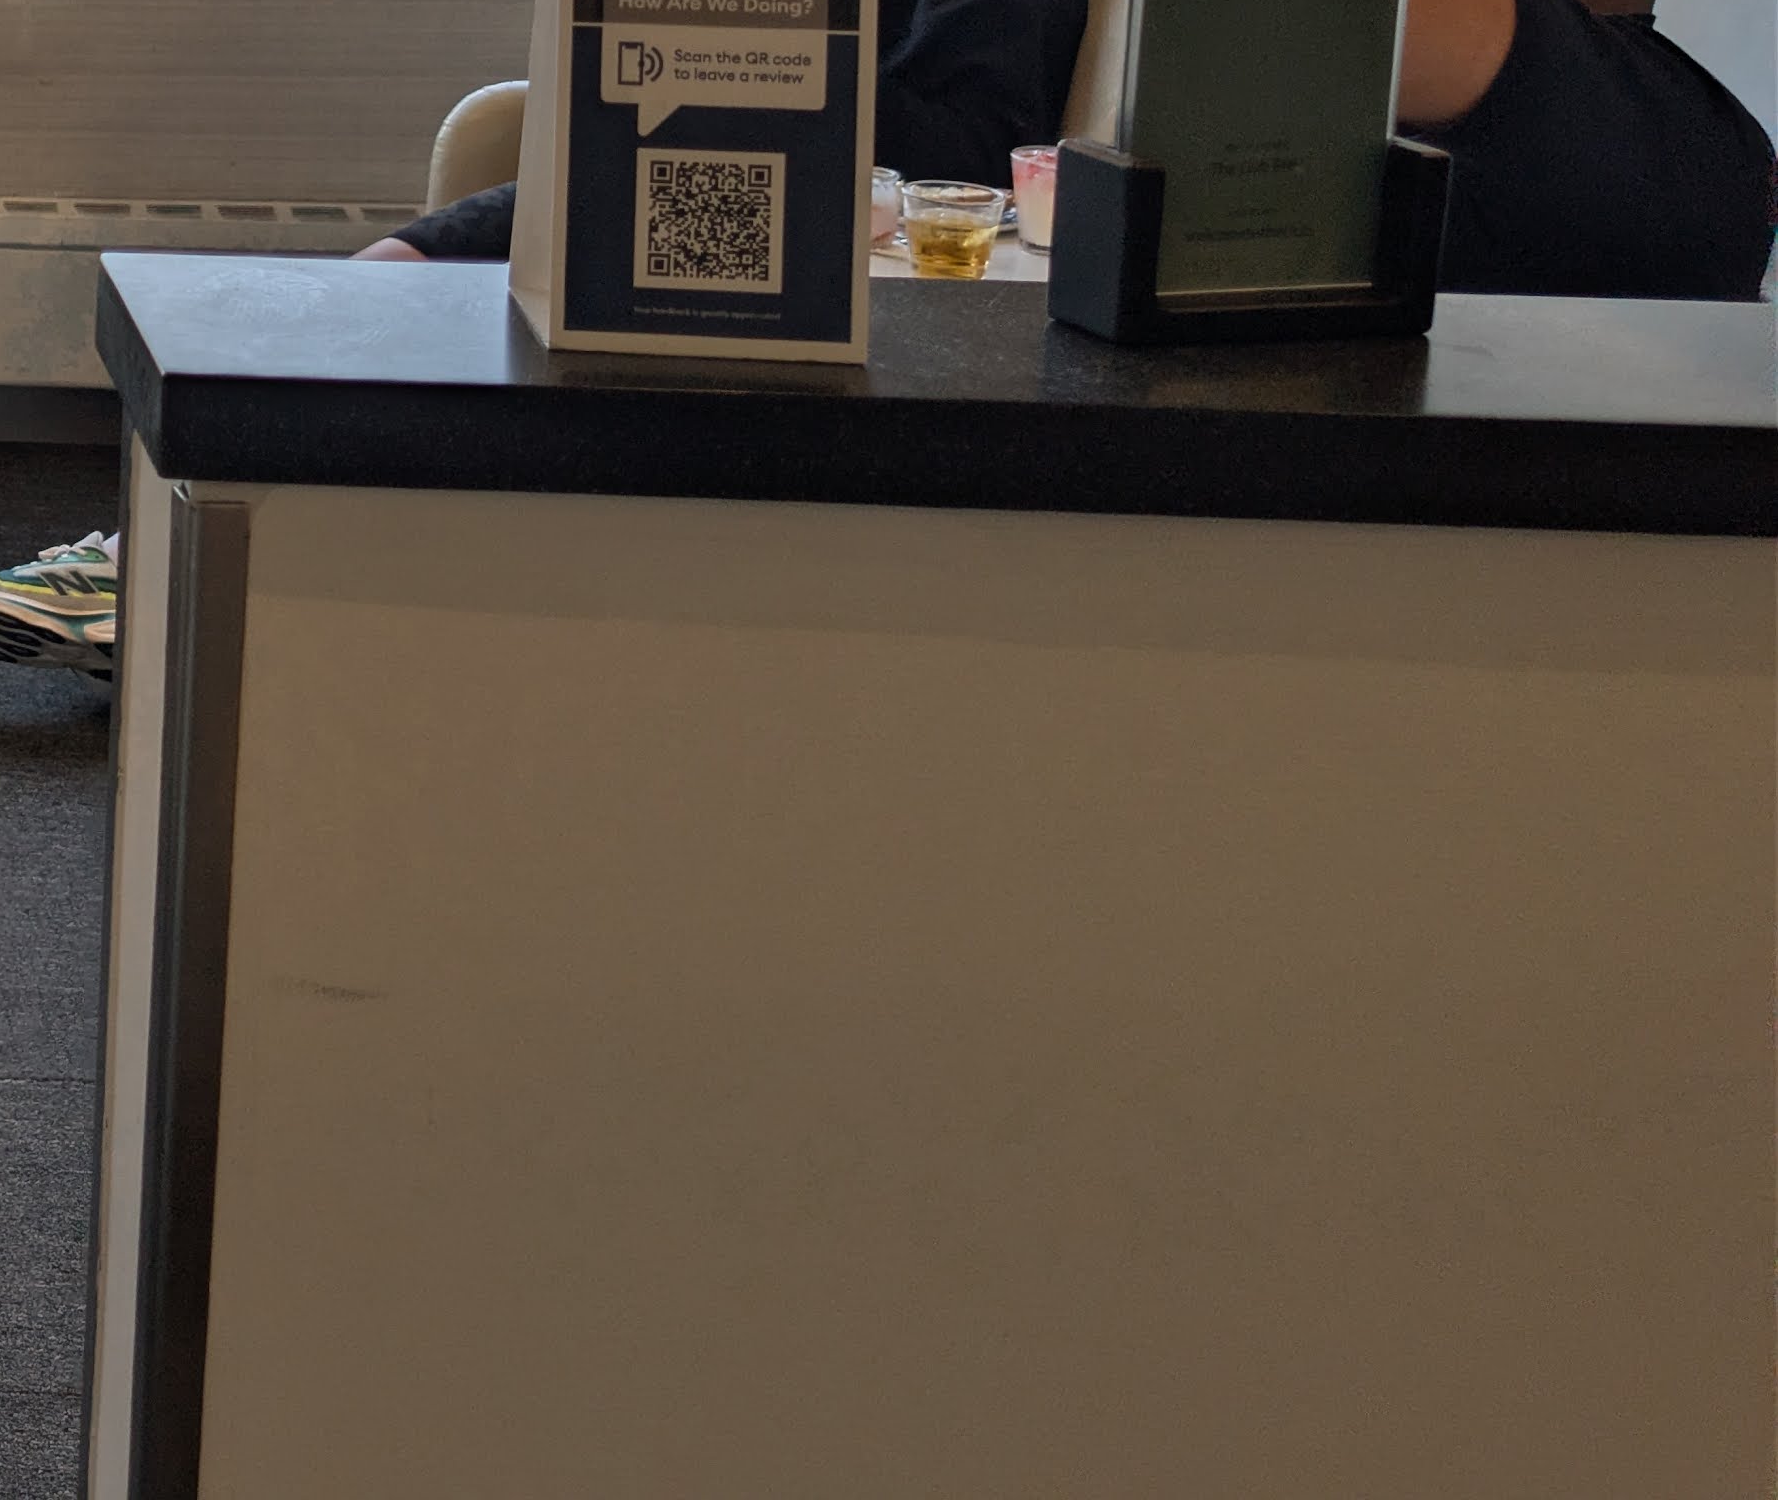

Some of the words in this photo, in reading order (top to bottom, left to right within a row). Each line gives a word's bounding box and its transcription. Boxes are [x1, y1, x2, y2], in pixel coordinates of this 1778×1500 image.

[673, 49, 712, 63] Scan
[716, 50, 742, 65] the
[745, 51, 770, 66] QR
[772, 51, 812, 67] code
[674, 68, 691, 81] to
[694, 67, 736, 82] leave
[739, 71, 749, 83] a
[753, 69, 805, 85] review
